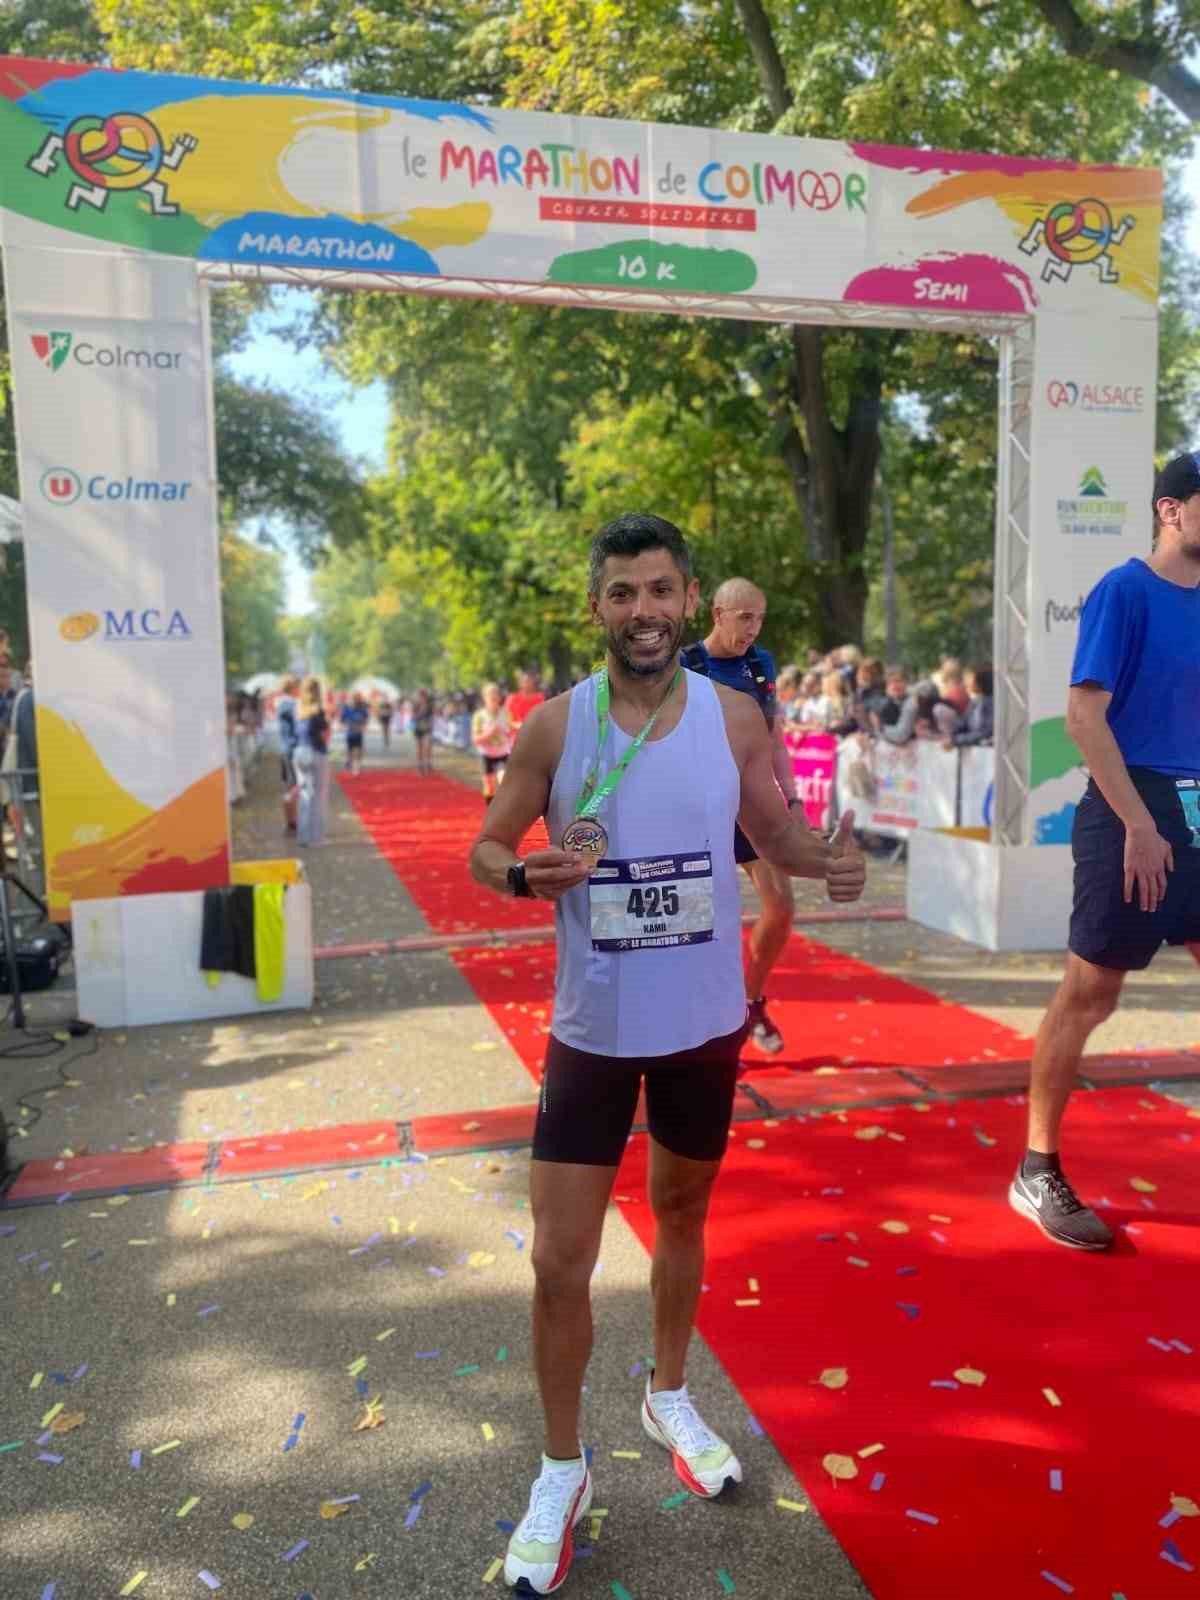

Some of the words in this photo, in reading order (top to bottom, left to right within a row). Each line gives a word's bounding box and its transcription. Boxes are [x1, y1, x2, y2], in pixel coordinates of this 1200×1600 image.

[402, 136, 428, 177] le
[440, 140, 641, 195] MARATHON
[658, 163, 686, 194] de
[552, 202, 629, 218] COURIR
[640, 208, 744, 225] SOLIDAIRE
[238, 231, 395, 262] MARATHON
[617, 255, 648, 280] 10
[657, 261, 676, 281] K
[913, 277, 968, 302] SEMI
[73, 343, 182, 370] Colmar
[1081, 384, 1144, 407] ALSACE
[88, 475, 191, 500] Colmar
[104, 608, 190, 637] MCA
[627, 885, 680, 918] 425
